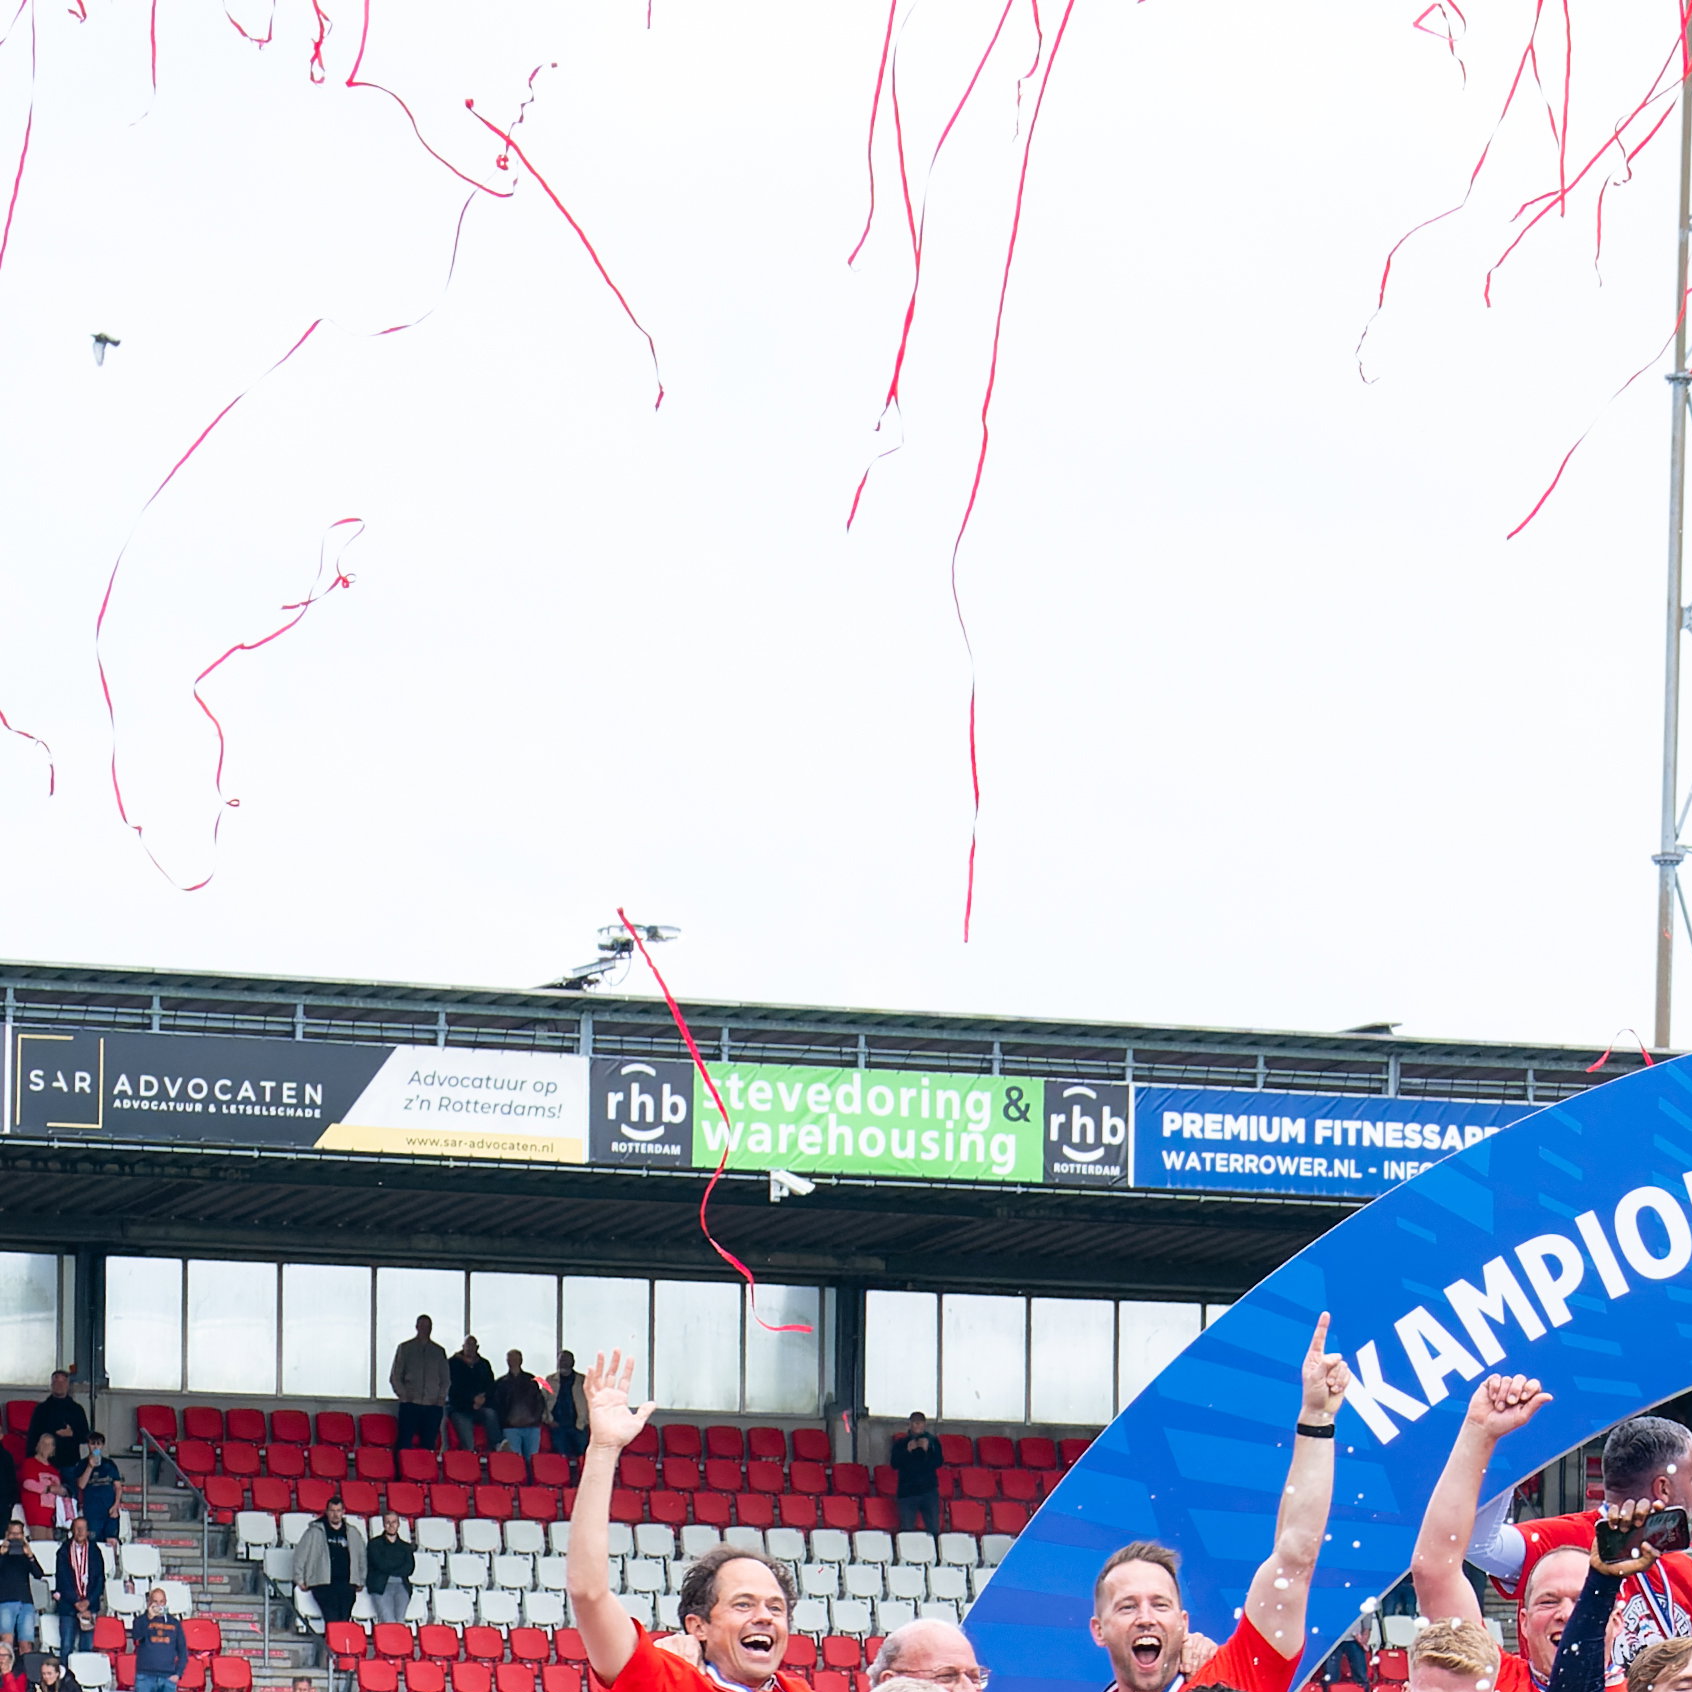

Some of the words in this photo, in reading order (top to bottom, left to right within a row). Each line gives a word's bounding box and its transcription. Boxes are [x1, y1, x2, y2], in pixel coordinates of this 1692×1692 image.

[29, 1069, 91, 1093] SAR
[113, 1074, 322, 1105] ADVOCATEN
[408, 1070, 527, 1092] Advocatuur
[533, 1081, 558, 1095] op
[113, 1099, 203, 1113] ADVOCATUUR
[208, 1104, 216, 1114] &
[222, 1105, 322, 1118] LETSELSCHADE
[438, 1096, 563, 1119] Rotterdams!
[607, 1083, 687, 1125] rhb
[702, 1073, 992, 1131] stevedoring
[1002, 1085, 1031, 1123] &
[1049, 1105, 1126, 1146] rhb
[1162, 1112, 1306, 1143] PREMIUM
[405, 1136, 555, 1153] www.sar-advocaten.nl
[611, 1142, 681, 1155] ROTTERDAM
[701, 1113, 1017, 1173] warehousing
[1053, 1163, 1121, 1176] ROTTERDAM
[1161, 1151, 1363, 1179] WATERROWER.NL
